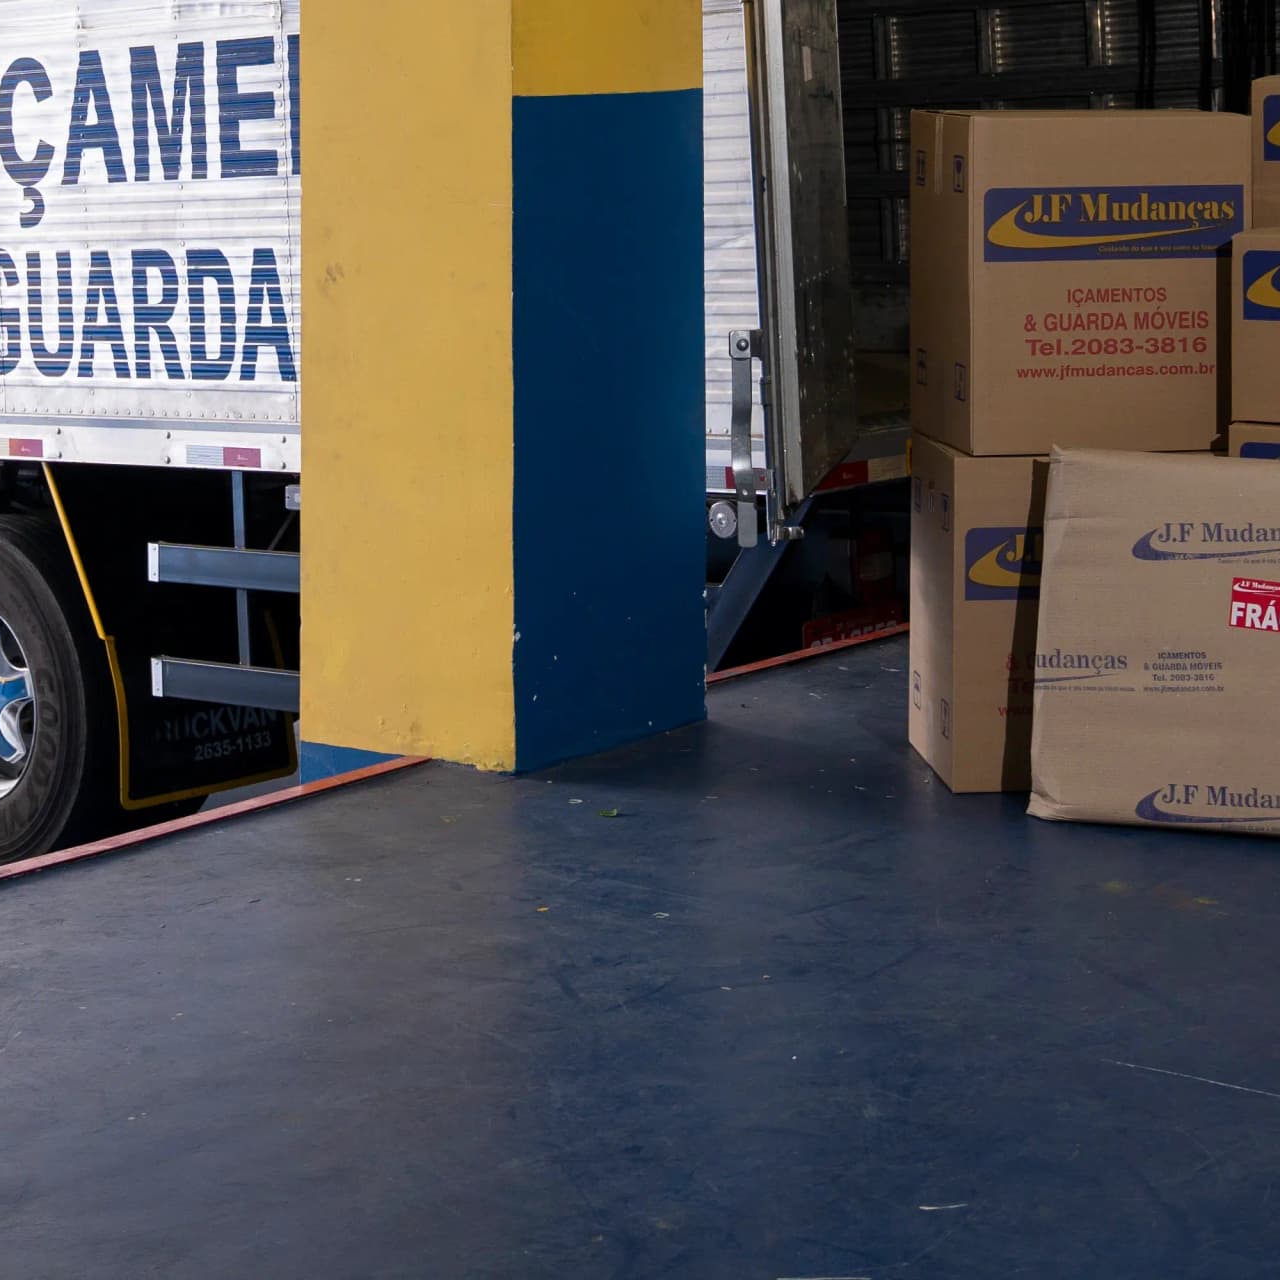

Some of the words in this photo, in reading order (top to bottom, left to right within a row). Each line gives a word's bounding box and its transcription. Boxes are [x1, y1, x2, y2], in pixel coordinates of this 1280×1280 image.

[1024, 194, 1071, 223] J.F
[1079, 192, 1234, 229] Mudanças
[1067, 287, 1167, 307] IÇAMENTOS
[1024, 314, 1037, 332] &
[1043, 312, 1127, 332] GUARDA
[1133, 307, 1208, 330] MÓVEIS
[1025, 337, 1207, 356] Tel.2083-3816
[1016, 363, 1215, 380] www.jfmudancas.com.br
[1157, 523, 1194, 543] J.F
[194, 733, 272, 761] 2635-1133
[1162, 784, 1198, 805] J.F
